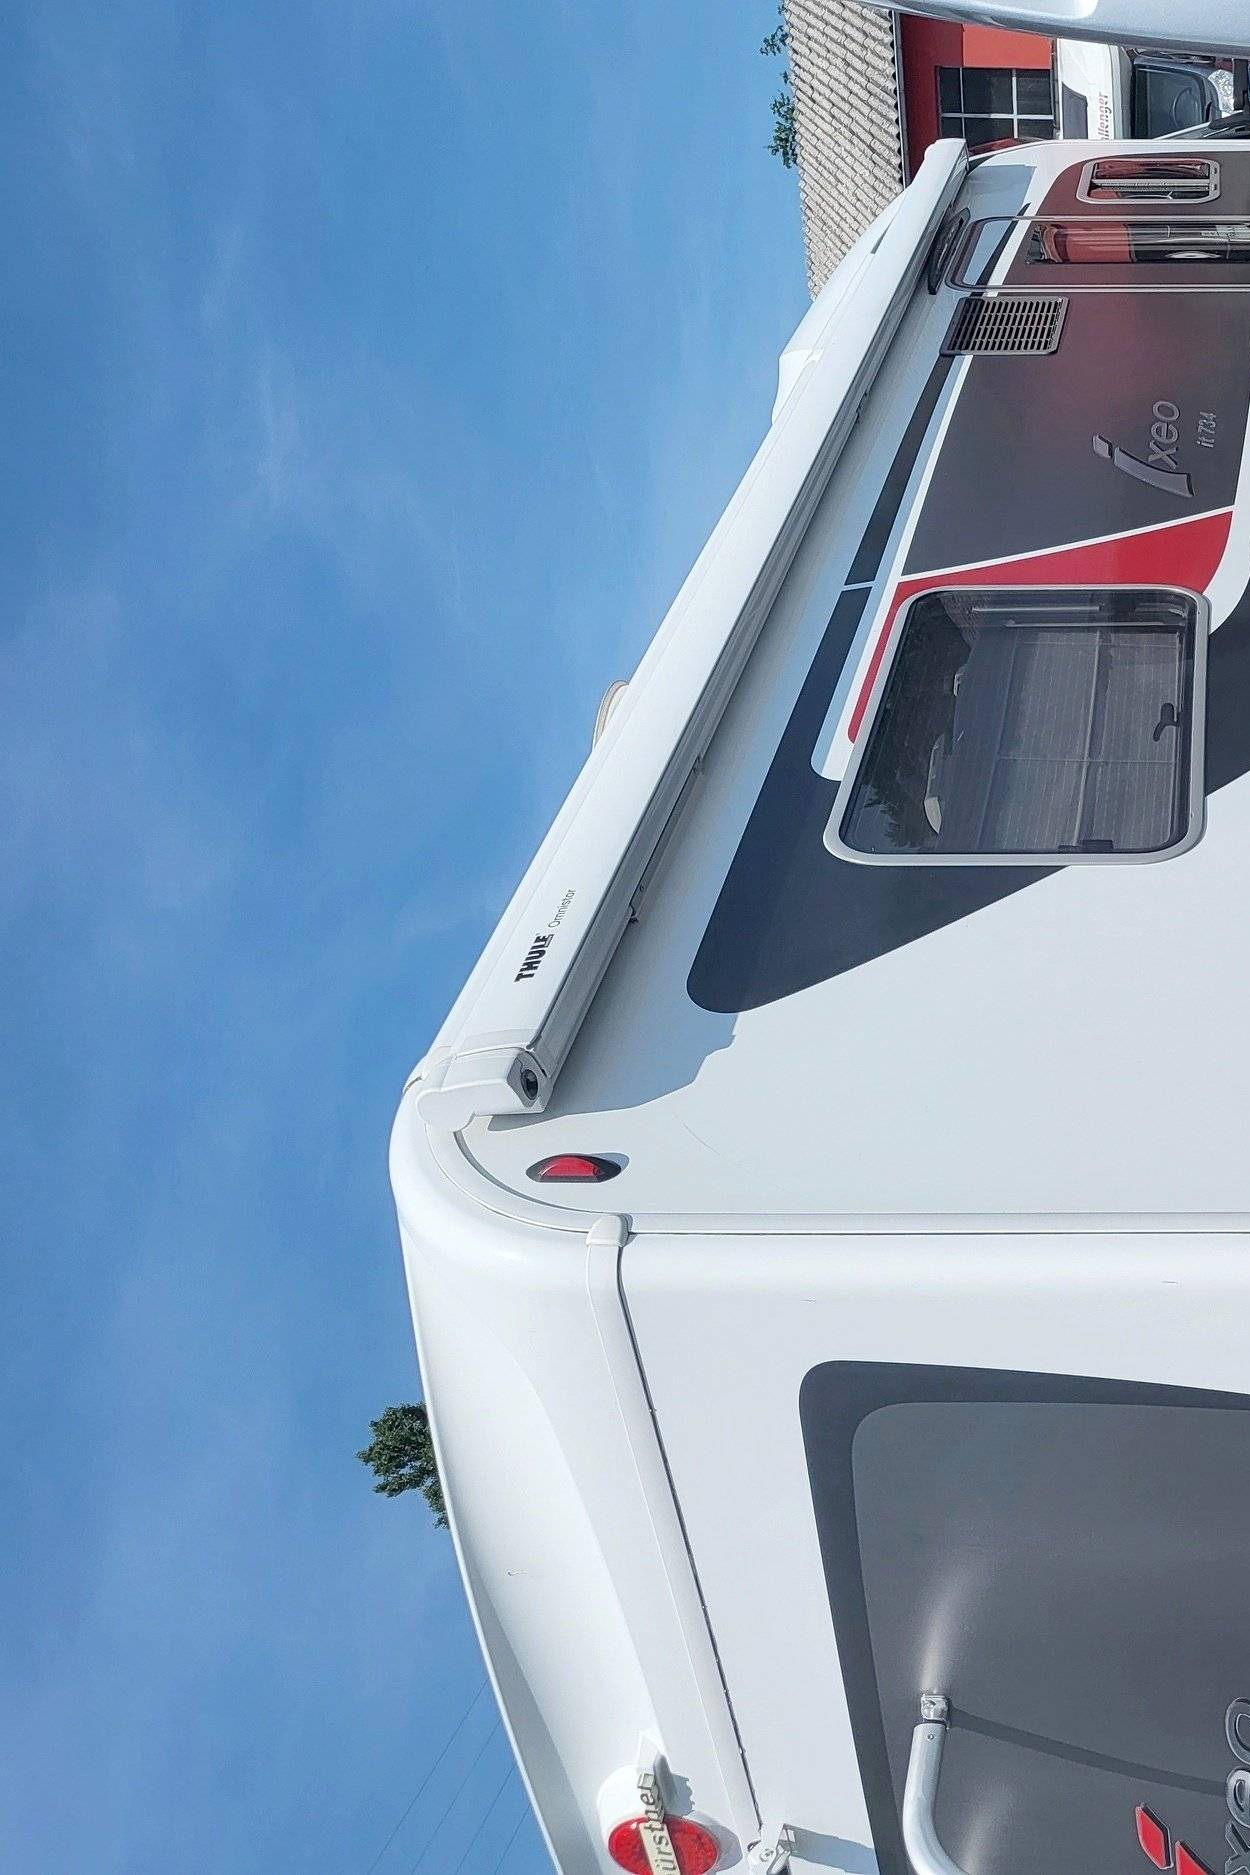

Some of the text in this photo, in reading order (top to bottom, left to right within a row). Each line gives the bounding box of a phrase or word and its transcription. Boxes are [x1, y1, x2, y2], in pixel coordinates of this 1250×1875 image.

[1197, 411, 1216, 448] it 734
[514, 890, 576, 982] THULE Omnistor
